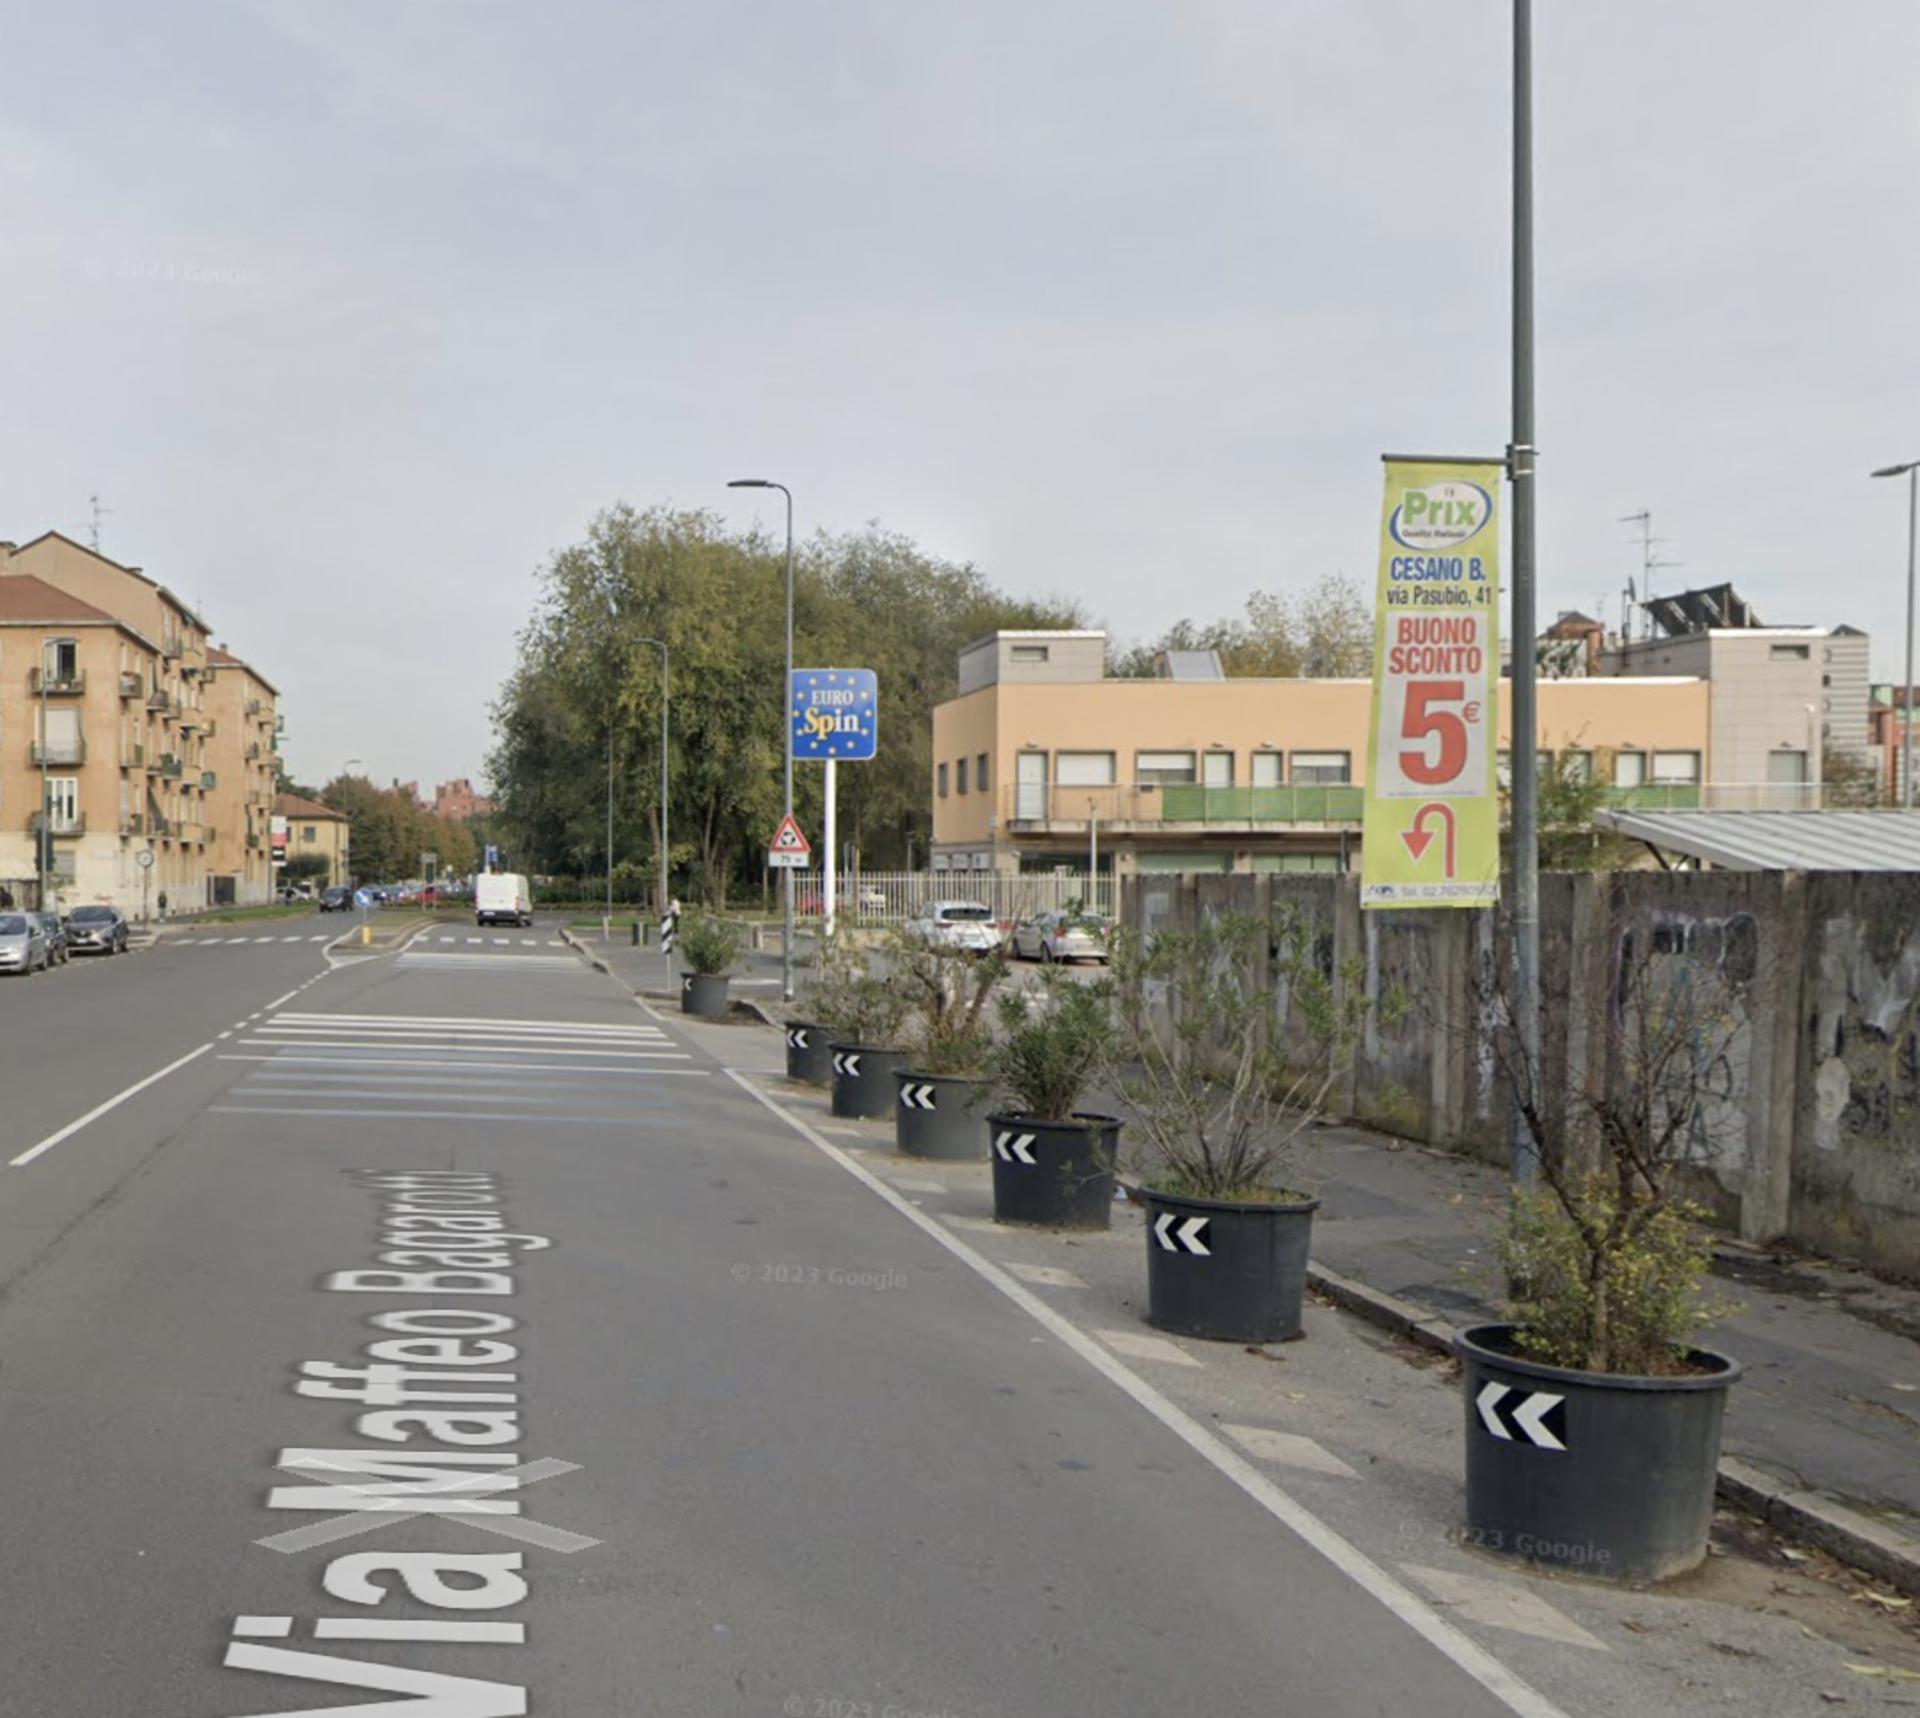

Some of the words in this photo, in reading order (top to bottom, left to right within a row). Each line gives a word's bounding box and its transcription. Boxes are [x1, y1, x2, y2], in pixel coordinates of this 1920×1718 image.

[1403, 491, 1476, 525] Prix
[1391, 557, 1463, 580] CESANO
[1469, 558, 1486, 580] B.
[1387, 586, 1408, 604] via
[1414, 586, 1472, 606] Pasubio,
[1476, 586, 1491, 604] 41
[1398, 617, 1476, 644] BUONO
[1389, 647, 1482, 674] SCONTO
[812, 690, 854, 705] EURO
[804, 707, 860, 739] Spin
